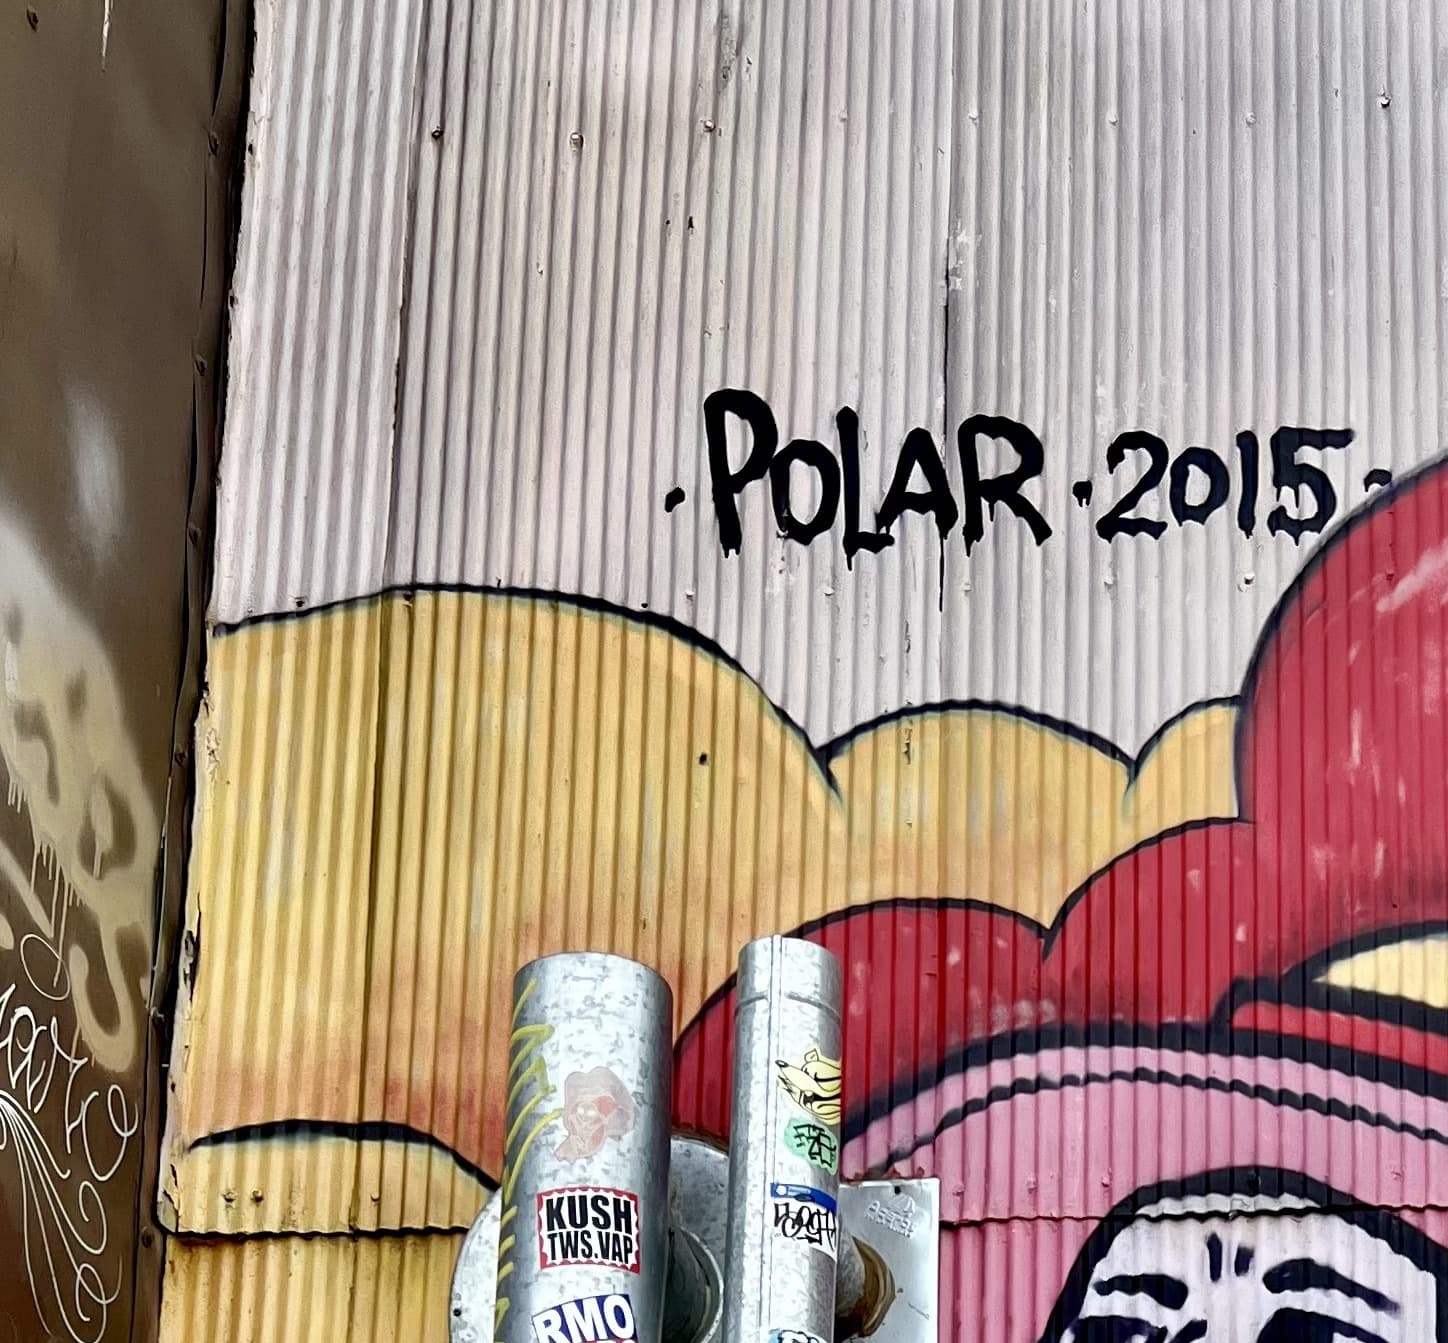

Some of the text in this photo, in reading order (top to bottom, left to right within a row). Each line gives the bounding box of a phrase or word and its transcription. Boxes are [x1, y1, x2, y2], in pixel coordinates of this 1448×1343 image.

[1095, 426, 1354, 544] 2015
[546, 1194, 633, 1235] KUSH
[547, 1230, 633, 1264] TWS.VAP
